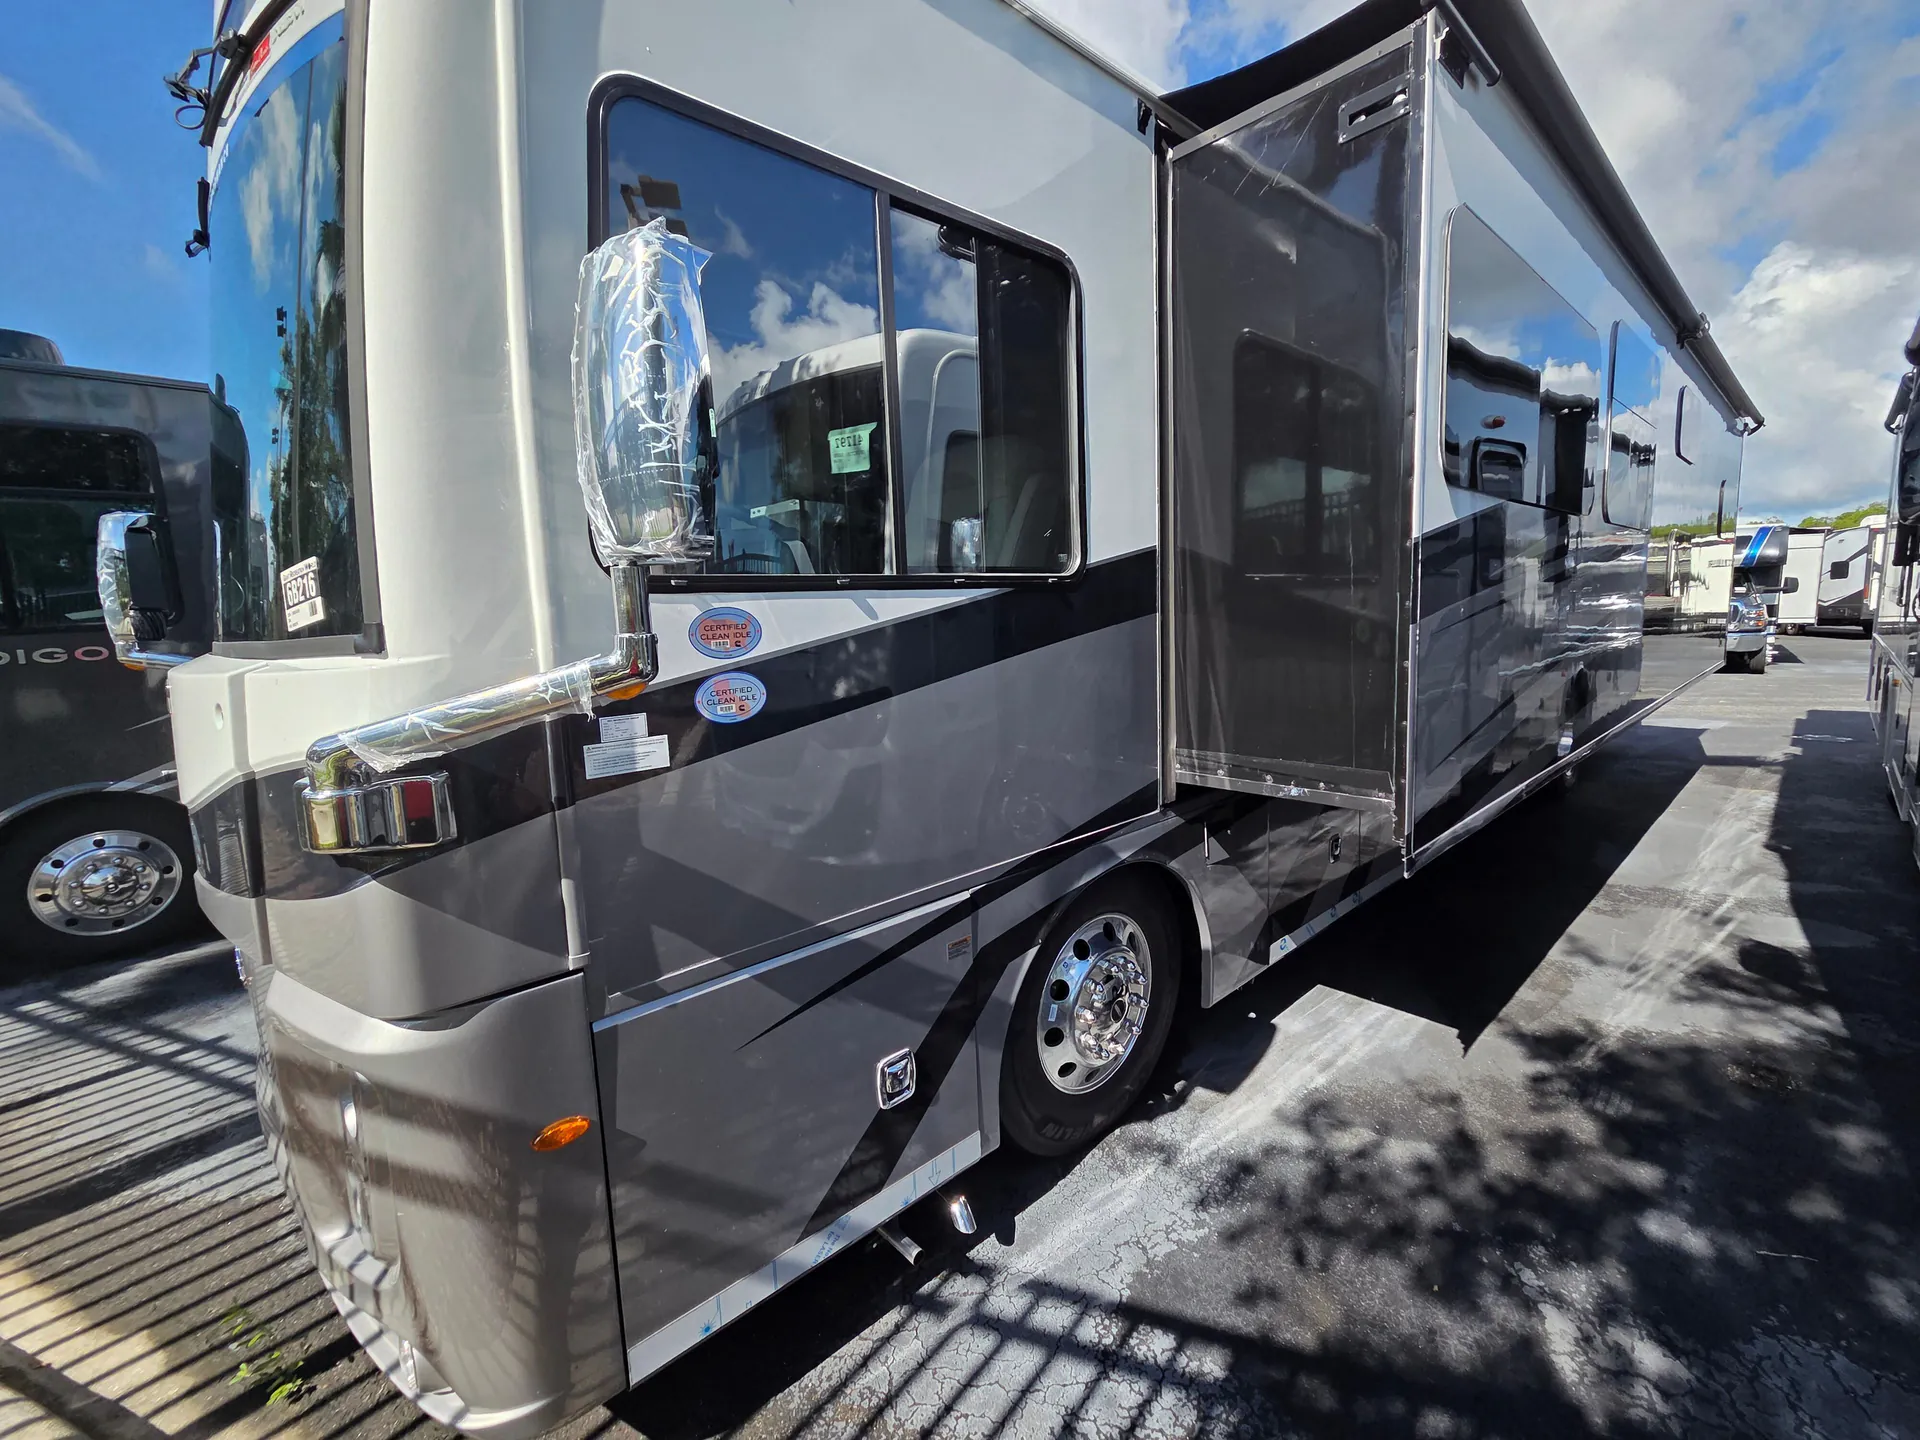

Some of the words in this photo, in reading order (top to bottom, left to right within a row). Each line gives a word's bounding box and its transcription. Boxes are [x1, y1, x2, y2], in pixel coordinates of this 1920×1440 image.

[286, 572, 316, 606] 6B216
[703, 623, 747, 632] CERTIFIED
[700, 632, 730, 641] CLEAN
[733, 631, 752, 639] IDLE
[710, 686, 753, 697] CERTIFIED
[706, 697, 736, 706] CLEAN
[738, 694, 757, 702] IDLE
